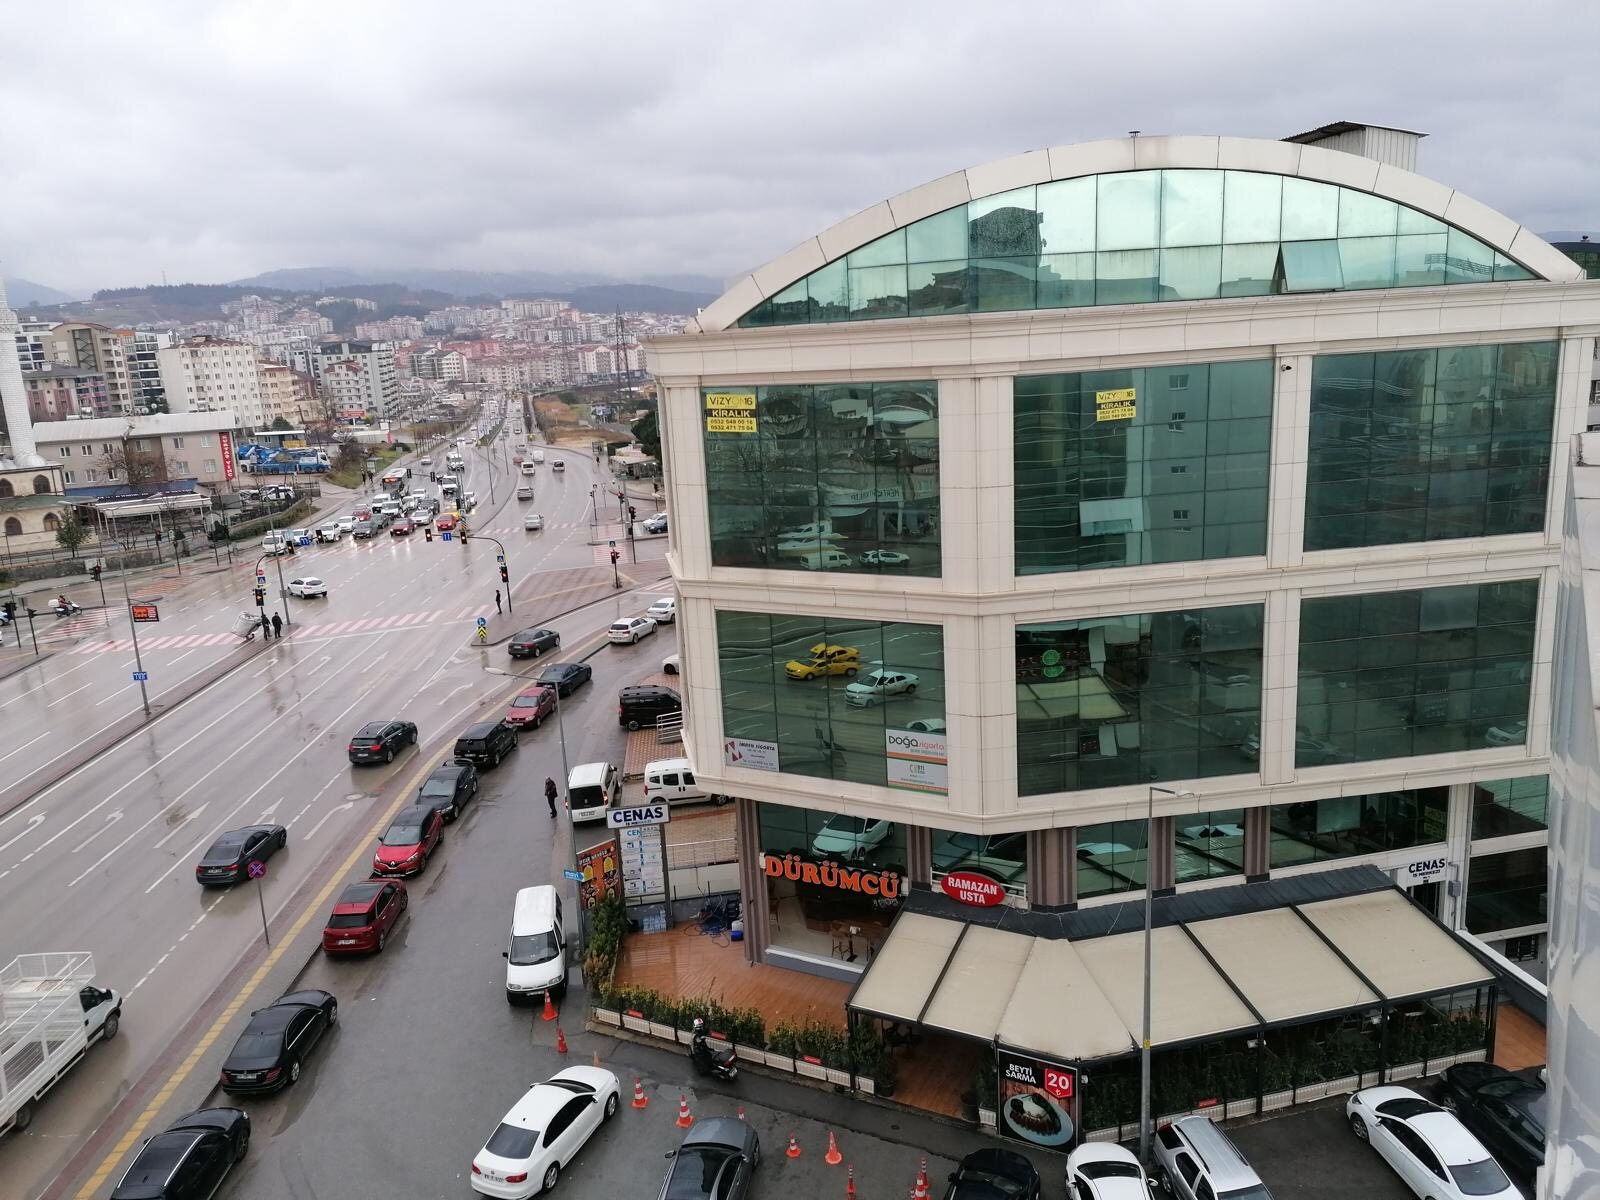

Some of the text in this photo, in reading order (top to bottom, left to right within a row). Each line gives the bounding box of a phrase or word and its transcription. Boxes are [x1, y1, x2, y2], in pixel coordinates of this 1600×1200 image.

[744, 397, 753, 405] 16
[712, 409, 750, 417] KİRALIK
[613, 807, 664, 823] CENAS
[1409, 858, 1445, 873] CENAS
[764, 854, 899, 898] DÜRÜMCÜ
[948, 877, 998, 895] RAMAZAN
[960, 890, 986, 904] USTA
[1009, 1064, 1032, 1075] BEYTİ
[1005, 1070, 1037, 1084] SARMA
[1047, 1073, 1069, 1089] 20
